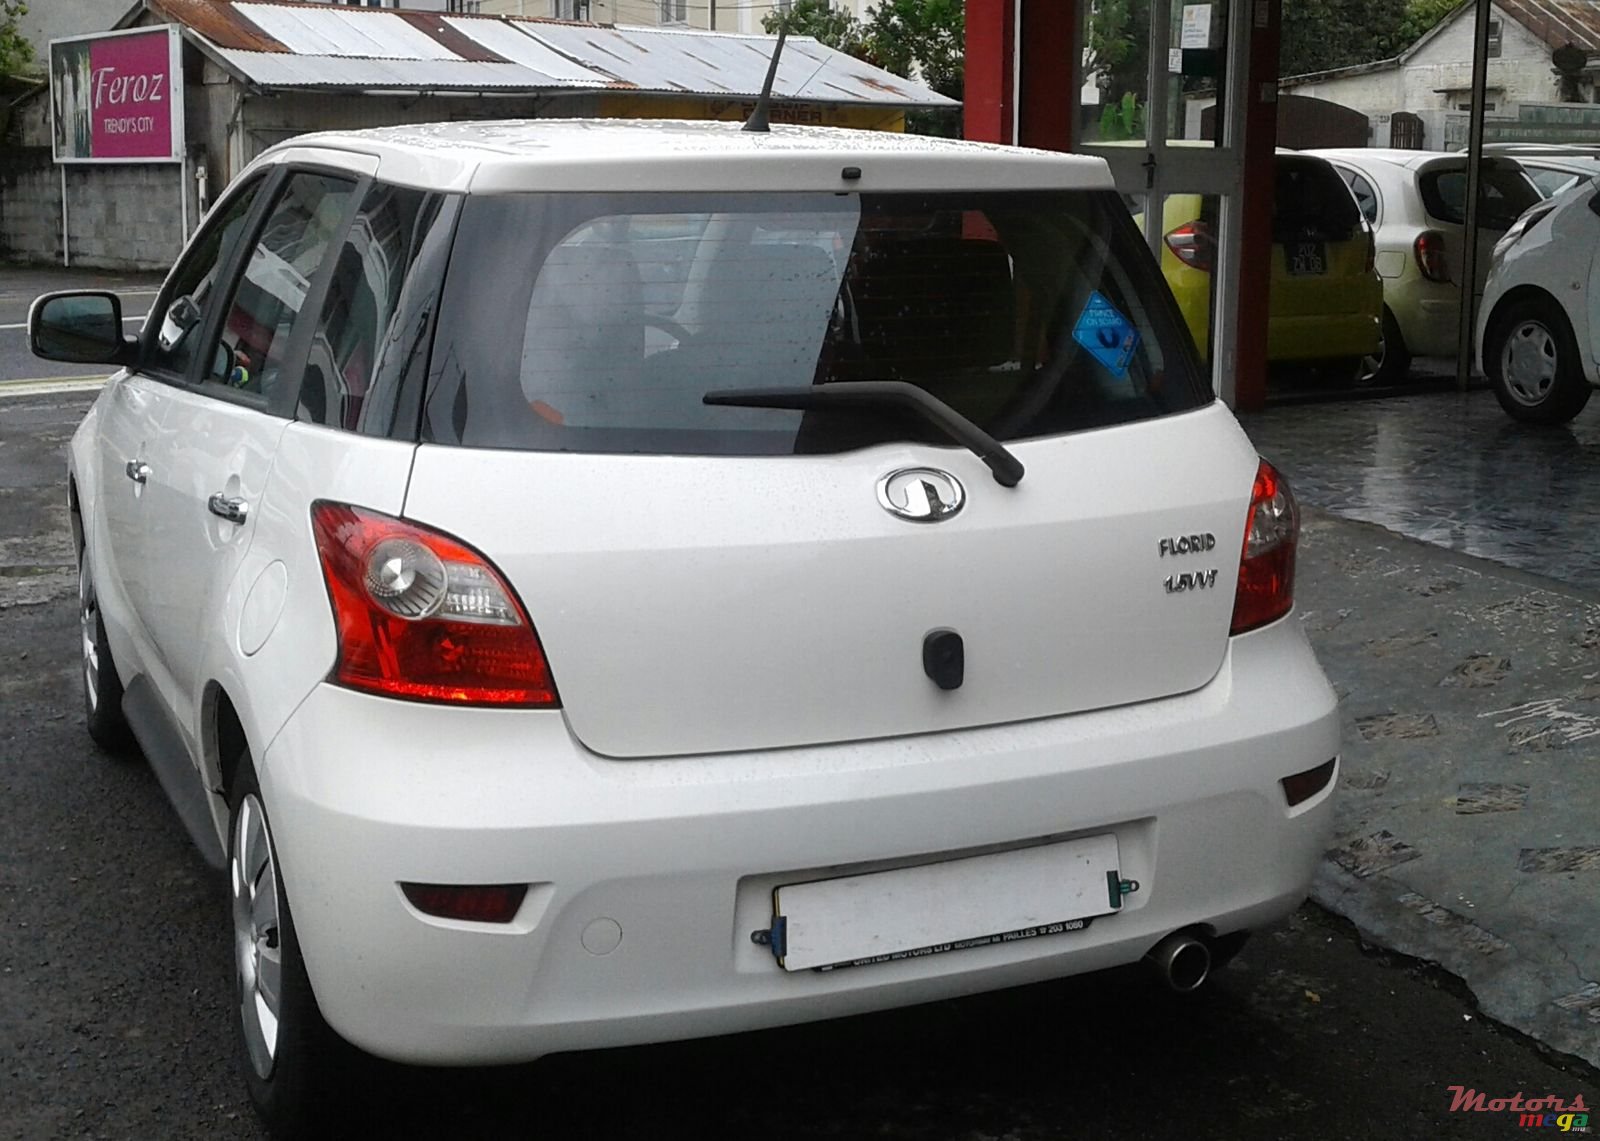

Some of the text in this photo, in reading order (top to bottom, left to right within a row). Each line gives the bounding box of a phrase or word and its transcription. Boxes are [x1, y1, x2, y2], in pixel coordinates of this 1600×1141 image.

[92, 67, 164, 110] Feroz
[137, 116, 154, 133] CITY
[1159, 532, 1216, 558] FLORID
